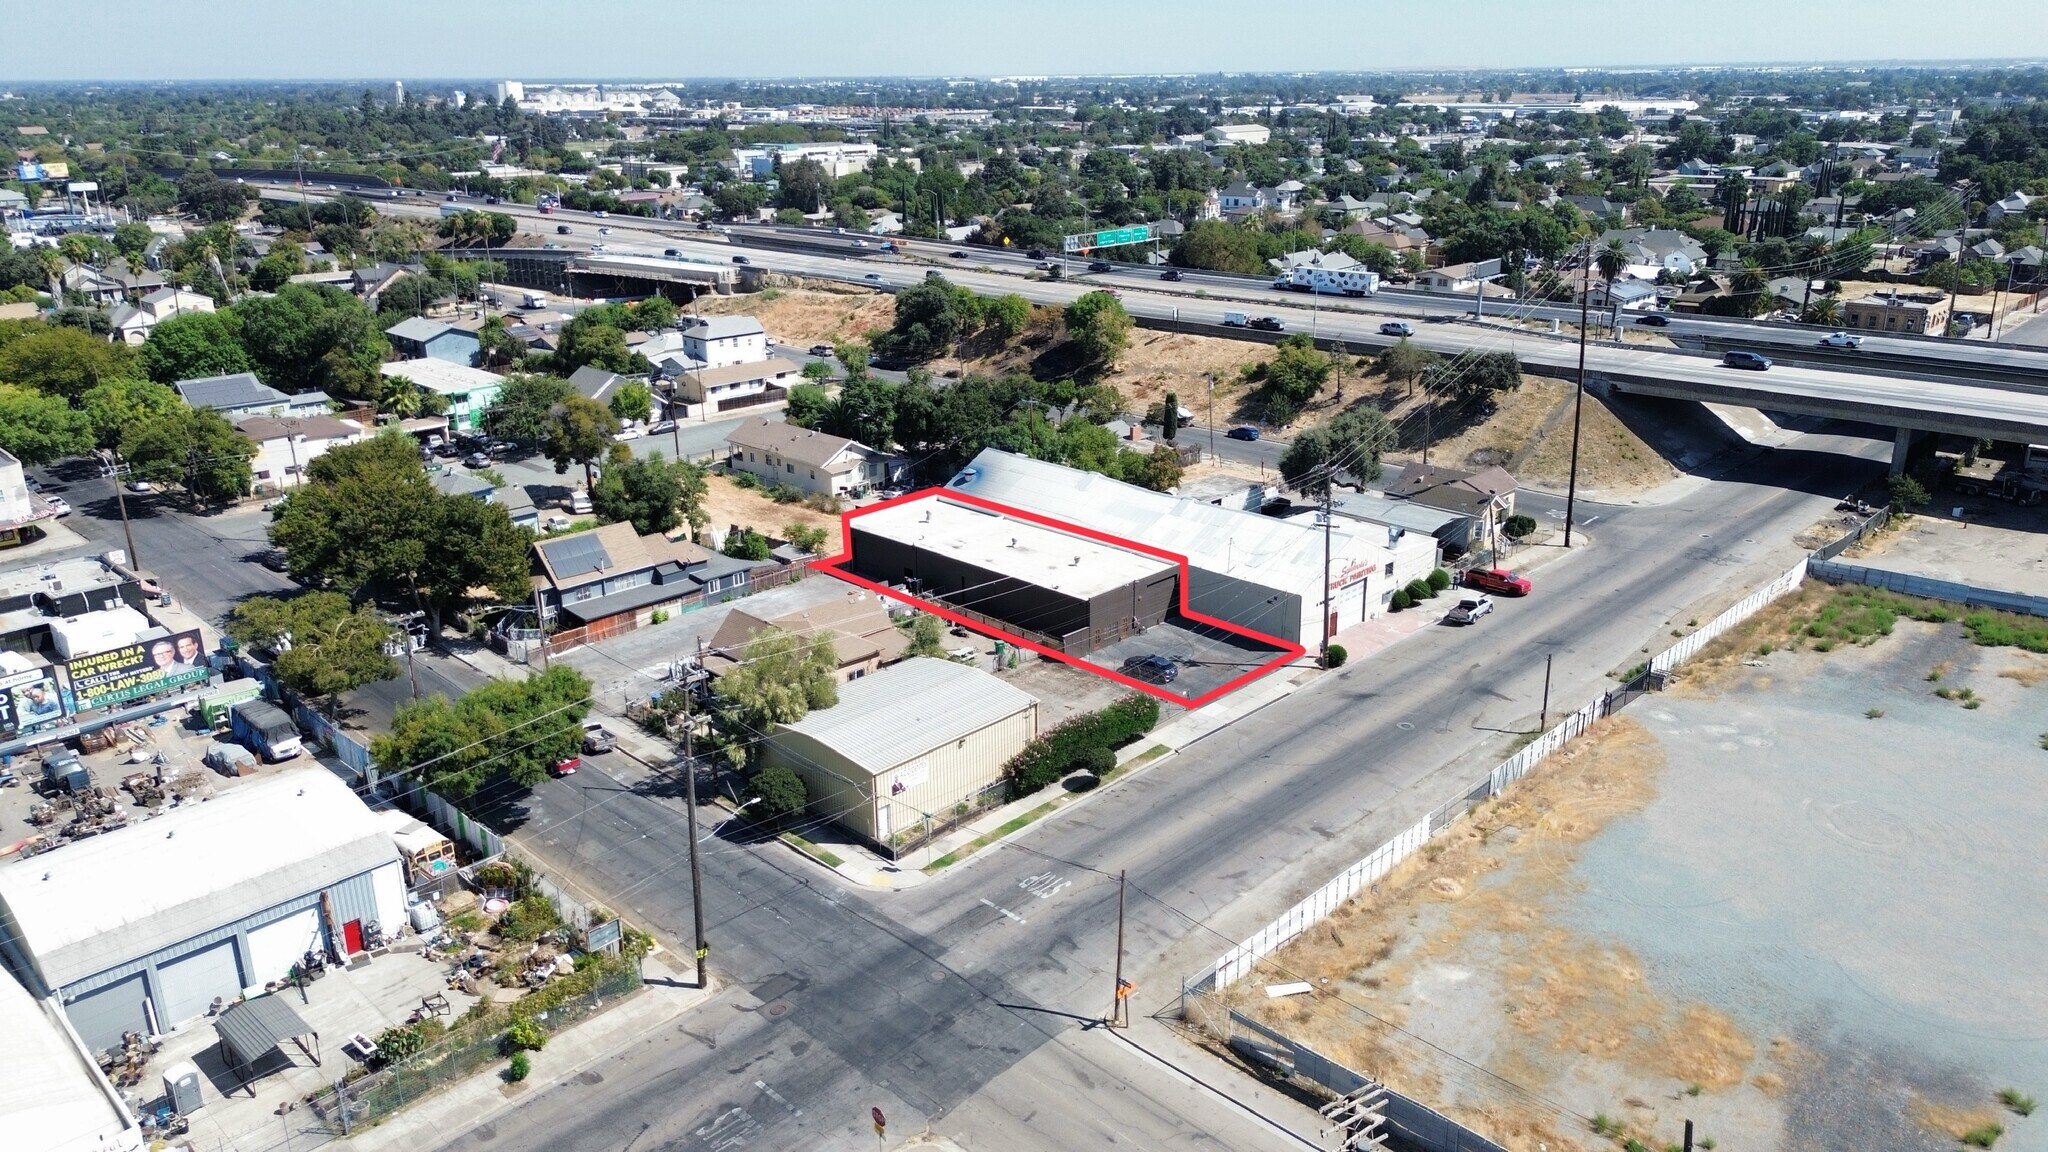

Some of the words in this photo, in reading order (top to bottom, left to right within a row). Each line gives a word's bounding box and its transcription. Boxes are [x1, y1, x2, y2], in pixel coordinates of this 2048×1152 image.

[69, 652, 119, 671] INJURED
[121, 648, 136, 657] IN
[136, 645, 146, 654] A
[71, 669, 96, 679] CAR
[97, 655, 144, 673] WRECK?
[76, 669, 166, 701] 1-800-LAW-3080
[84, 676, 107, 686] CALL
[91, 690, 131, 705] CURTIS
[133, 681, 168, 694] LEGAL
[169, 669, 206, 683] GROUP
[1019, 871, 1072, 898] STOP
